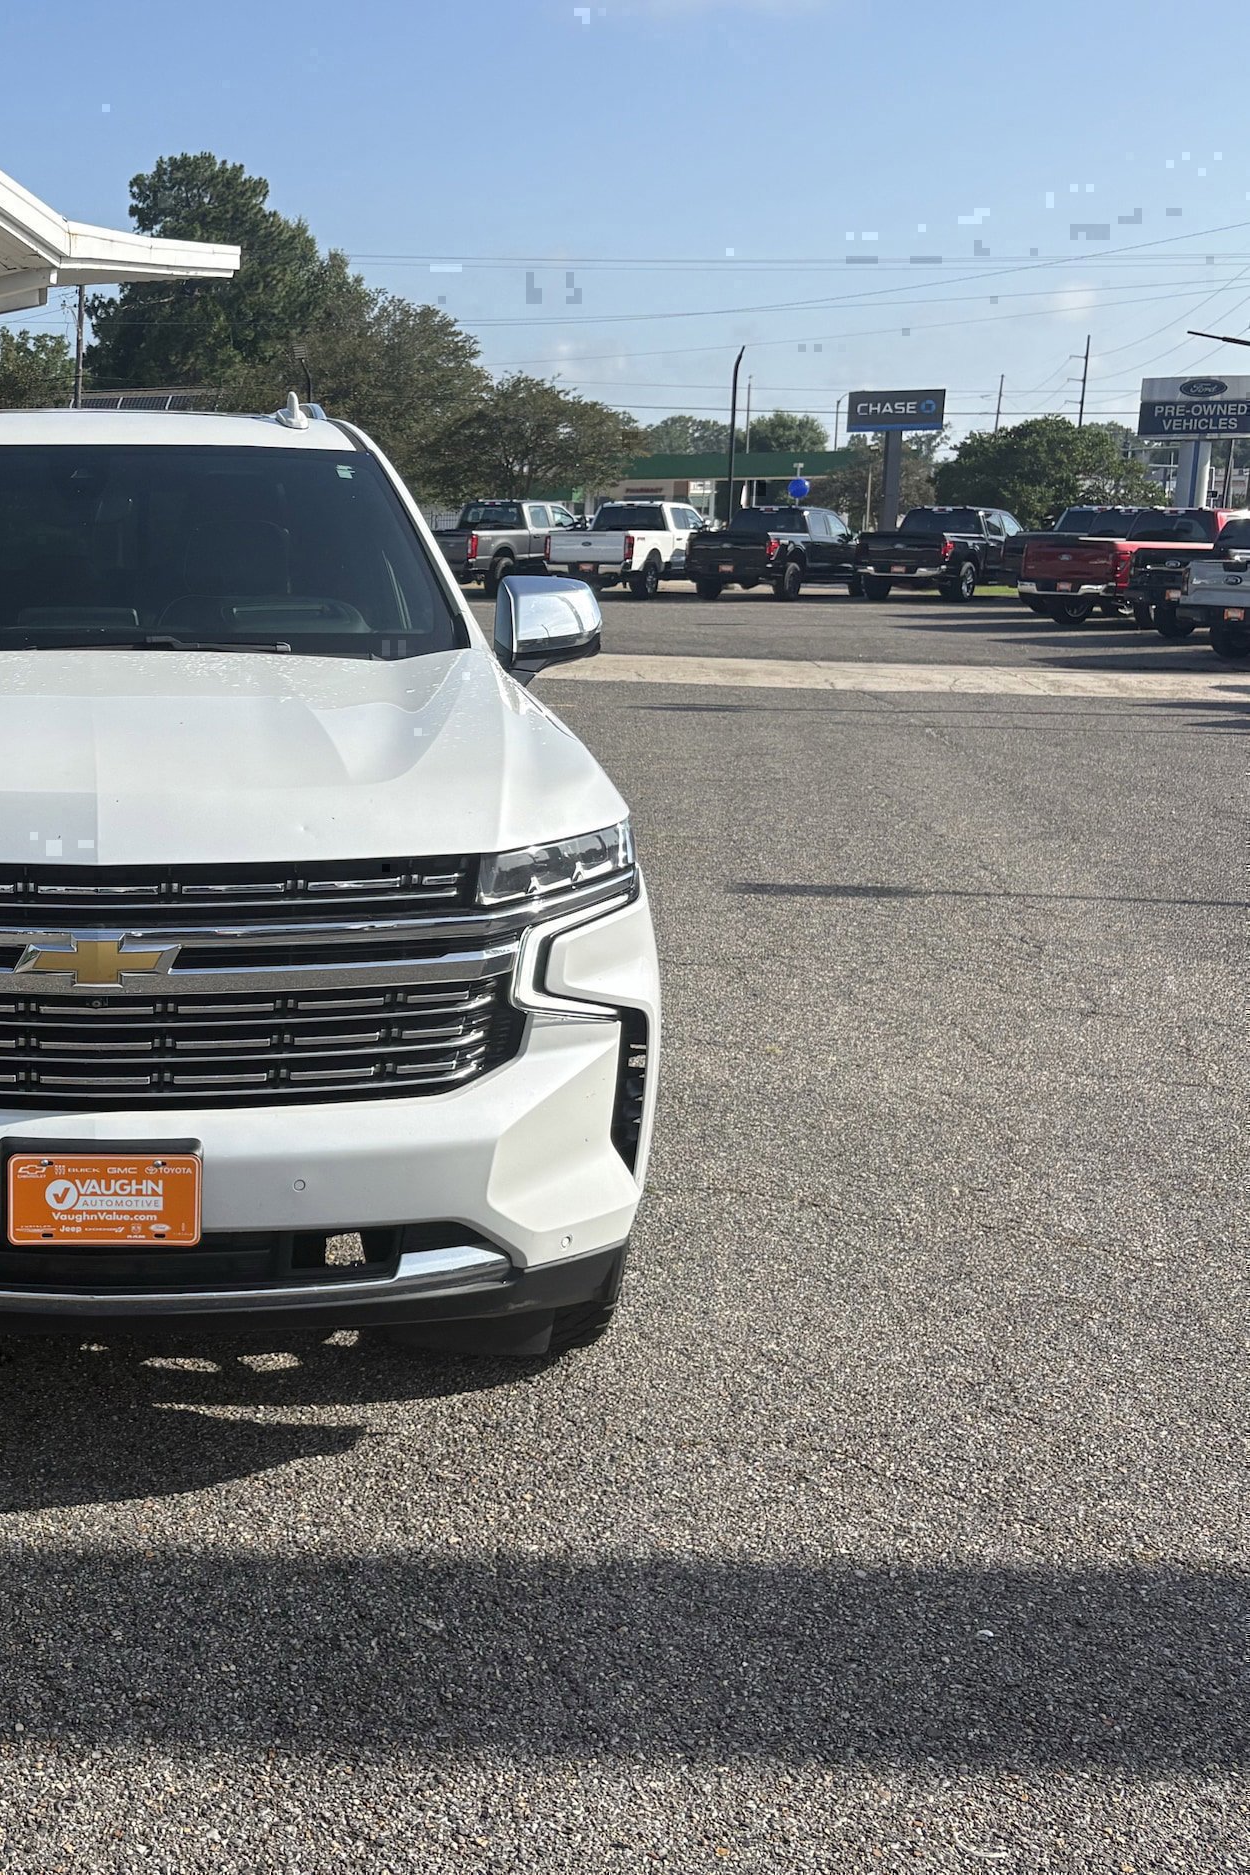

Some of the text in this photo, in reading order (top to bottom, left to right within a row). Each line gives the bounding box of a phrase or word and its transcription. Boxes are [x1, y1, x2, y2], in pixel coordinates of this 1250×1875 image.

[1190, 383, 1218, 393] Ford
[856, 401, 918, 416] CHASE
[1154, 403, 1248, 417] PRE-OWNED
[1162, 417, 1238, 431] VEHICLES
[107, 1166, 138, 1174] GMC
[159, 1166, 192, 1174] TOYOTA
[75, 1179, 163, 1195] VAUGHN
[82, 1199, 160, 1208] AUTOMOTIVE
[52, 1211, 158, 1223] VaughnValue.com
[59, 1225, 82, 1233] Jeep
